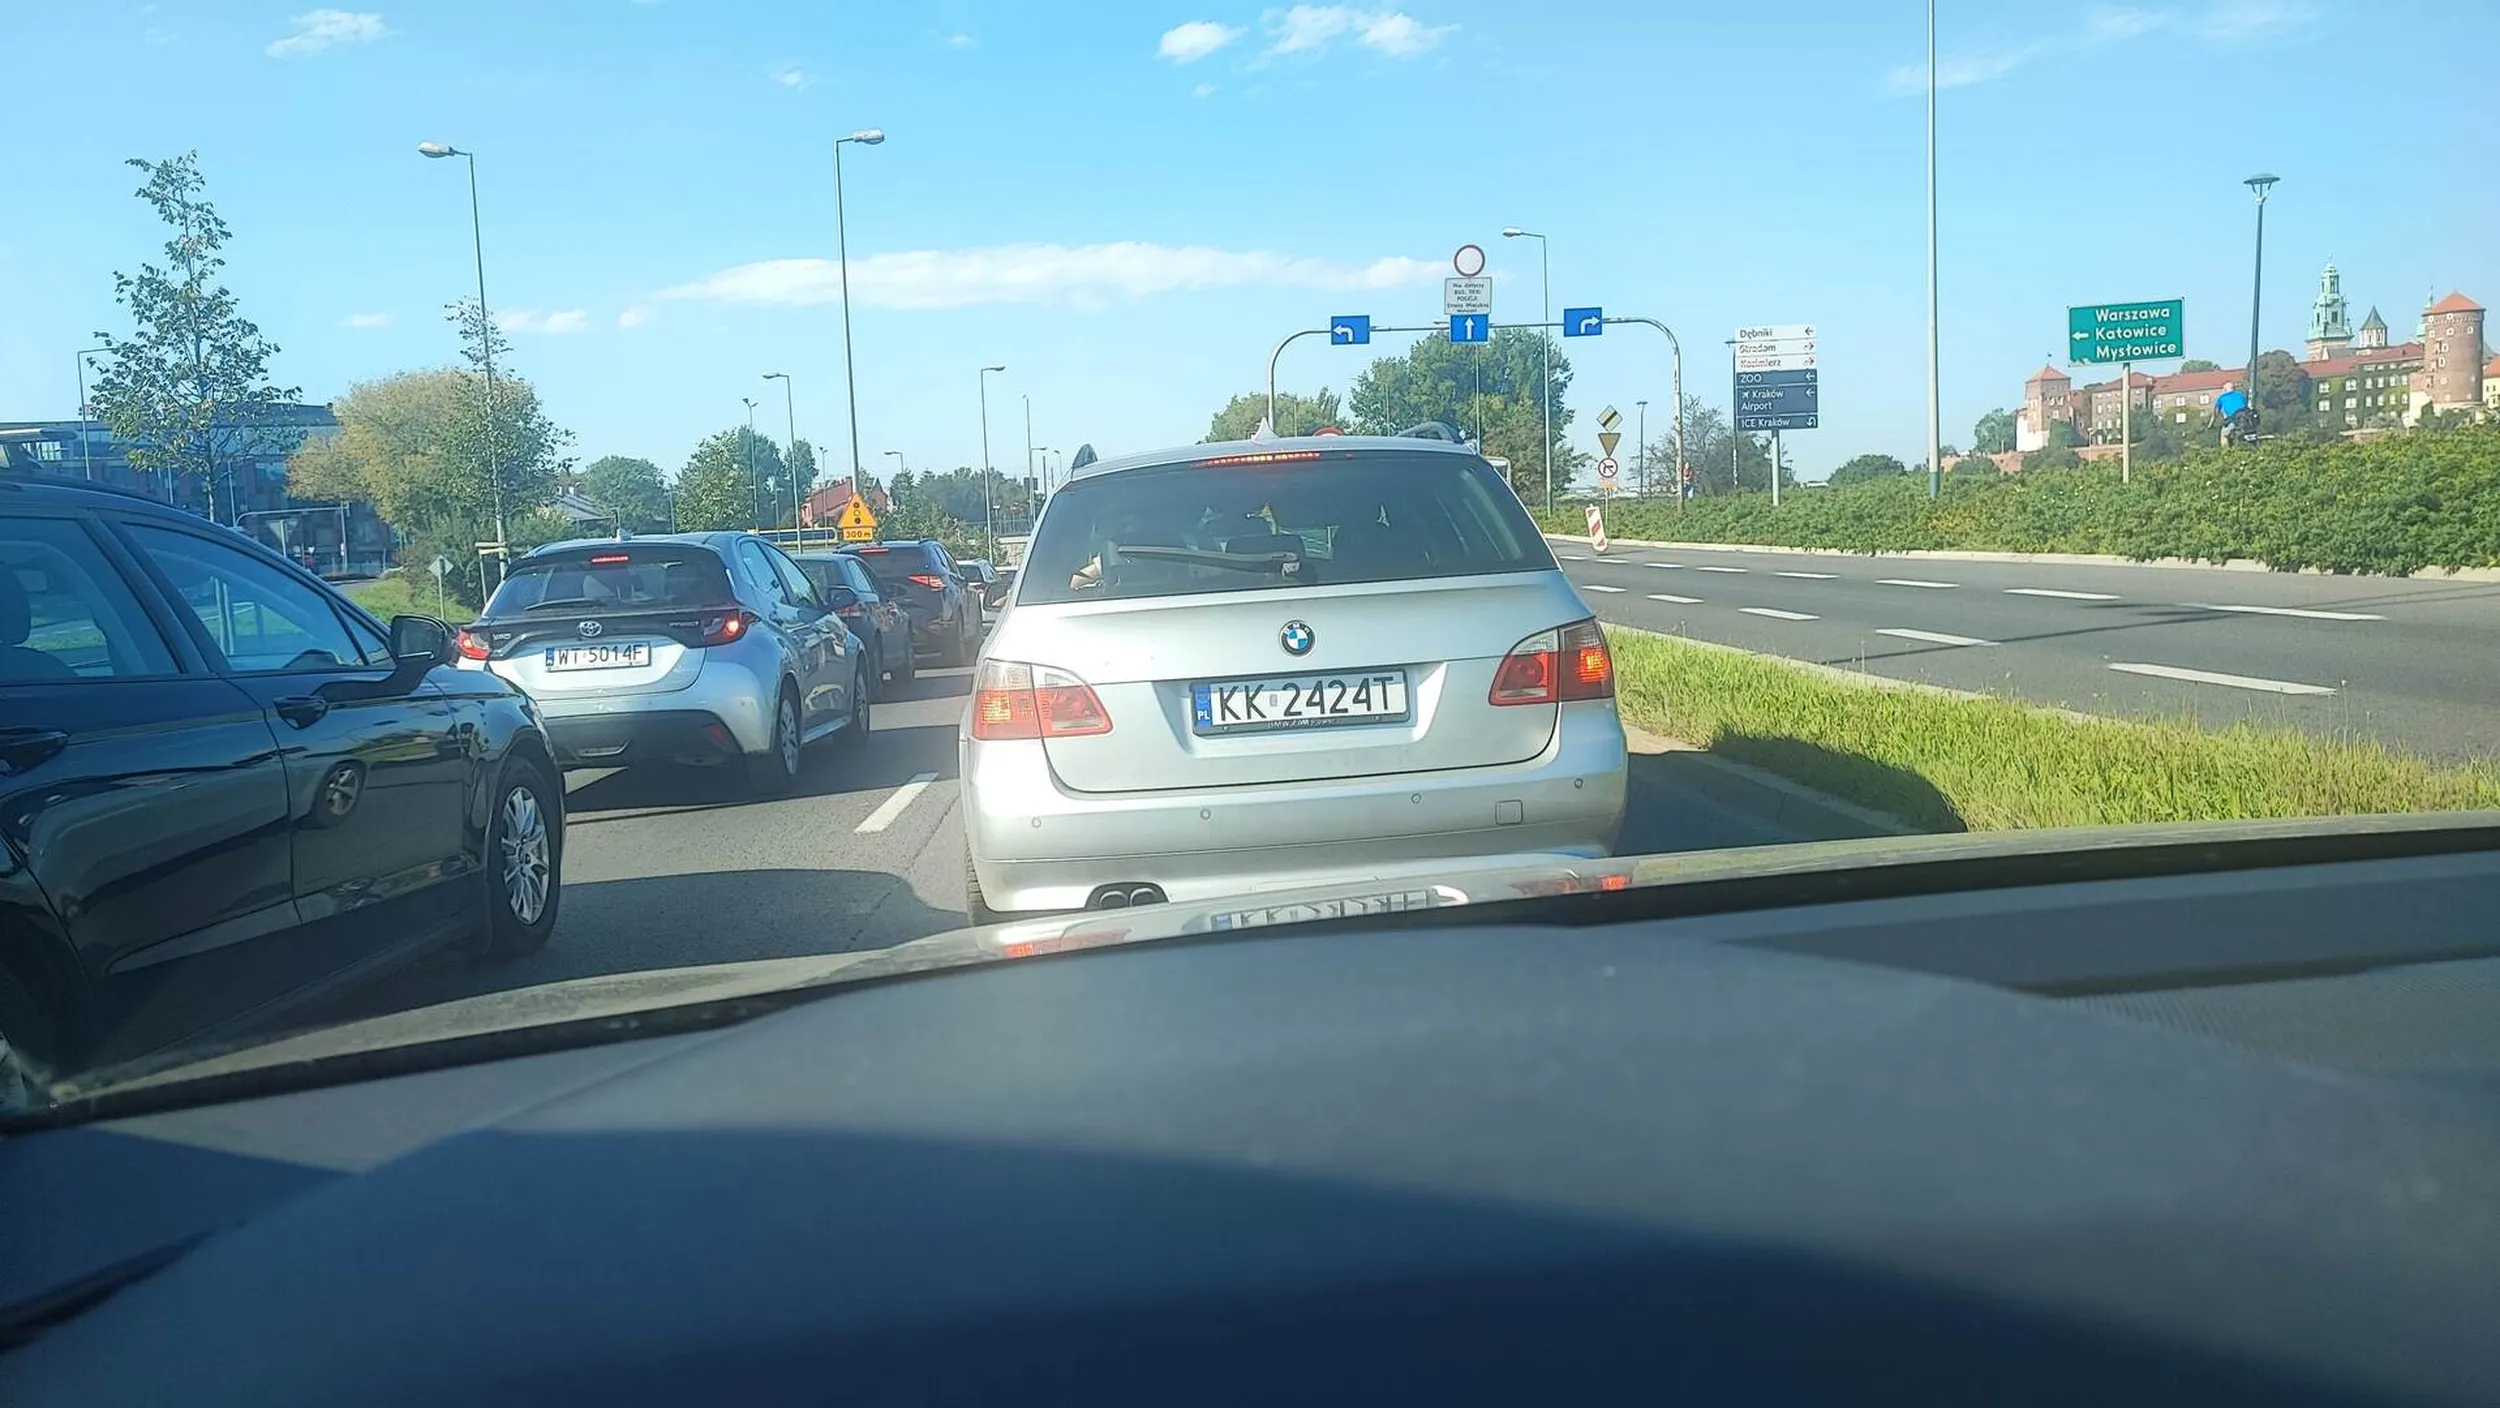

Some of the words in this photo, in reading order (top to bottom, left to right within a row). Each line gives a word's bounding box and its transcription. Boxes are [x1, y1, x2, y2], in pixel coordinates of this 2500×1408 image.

[2095, 308, 2170, 322] Warszawa
[1740, 328, 1773, 339] Dębniki
[2095, 323, 2167, 340] Katowice
[1740, 343, 1776, 354] Stradom
[2096, 341, 2176, 361] Mysłowice
[1740, 374, 1762, 383] ZOO
[1752, 389, 1784, 399] Kraków
[1741, 401, 1773, 411] Airport
[1741, 418, 1756, 428] ICE
[1758, 417, 1791, 427] Kraków
[559, 648, 581, 665] WT
[588, 644, 643, 663] 5014F
[1219, 684, 1267, 721] KK
[1282, 676, 1393, 717] 2424T
[1197, 710, 1210, 720] PL
